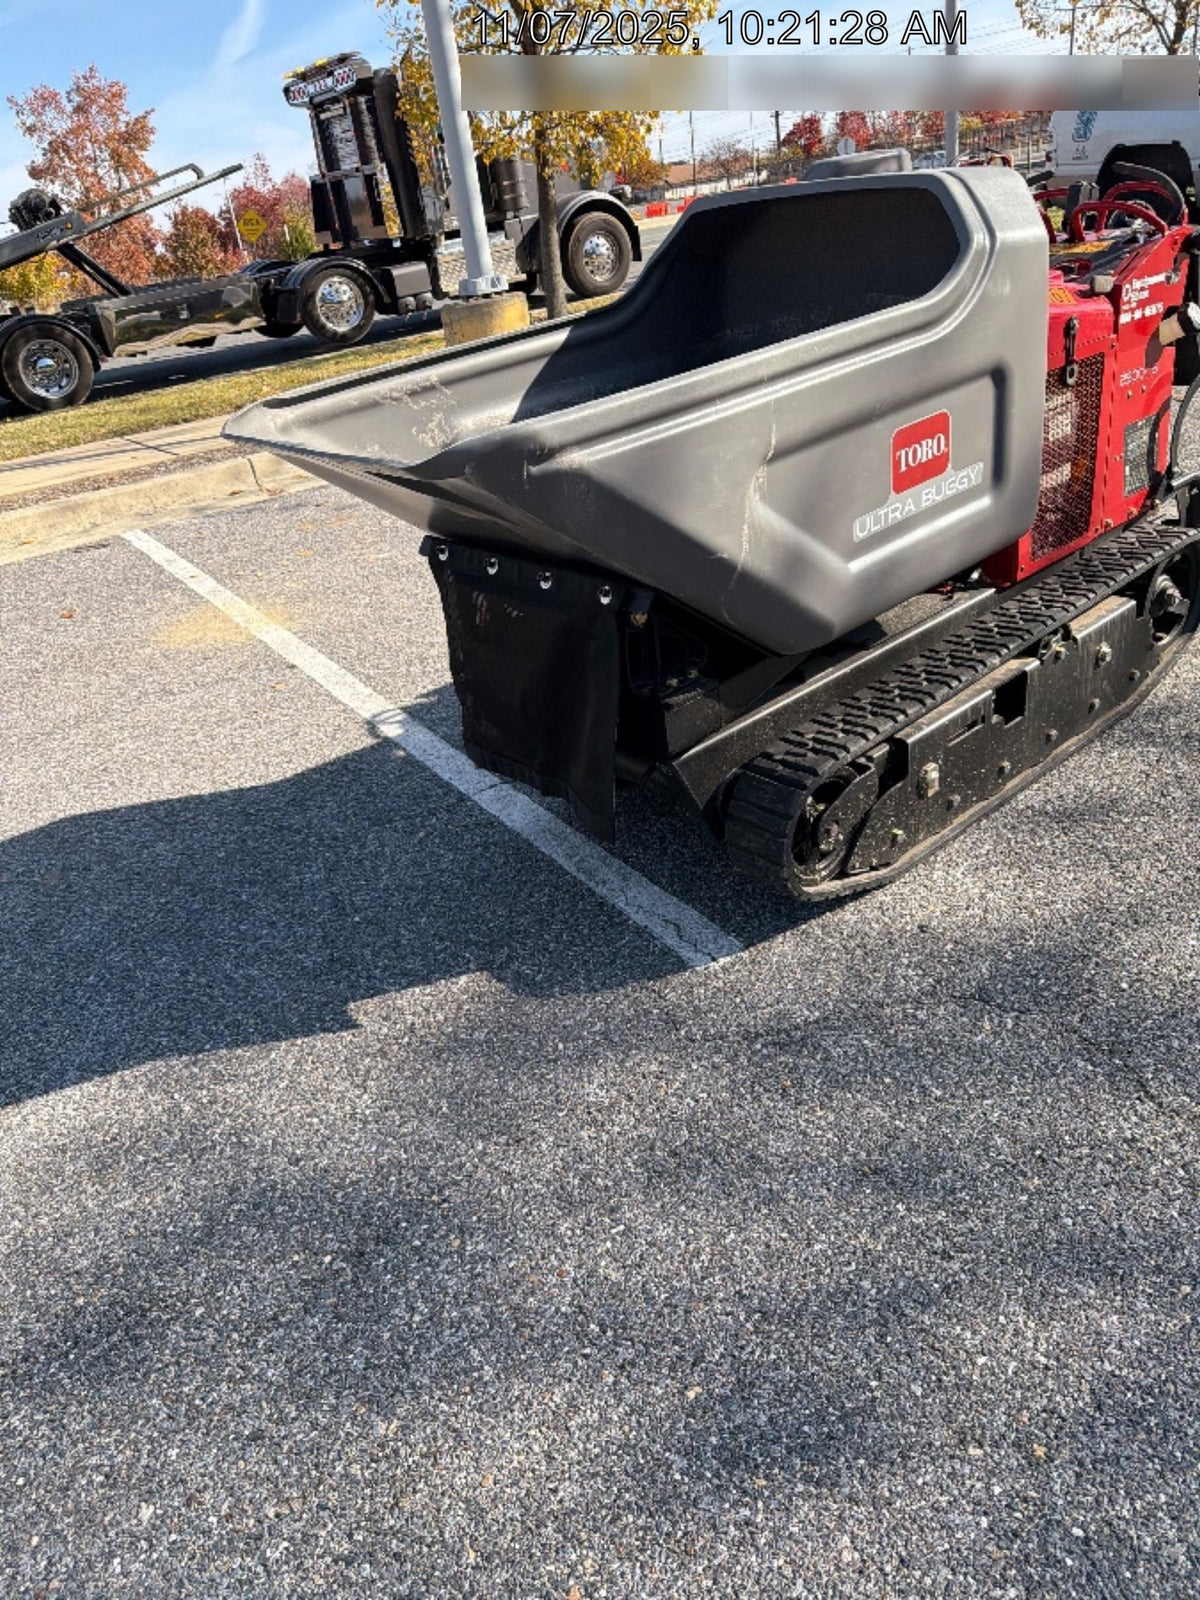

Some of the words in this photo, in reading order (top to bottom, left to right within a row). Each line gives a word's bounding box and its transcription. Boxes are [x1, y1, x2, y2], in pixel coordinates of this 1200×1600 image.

[896, 433, 946, 473] TORO
[856, 497, 916, 538] ULTRA
[921, 463, 983, 508] BUGGY
